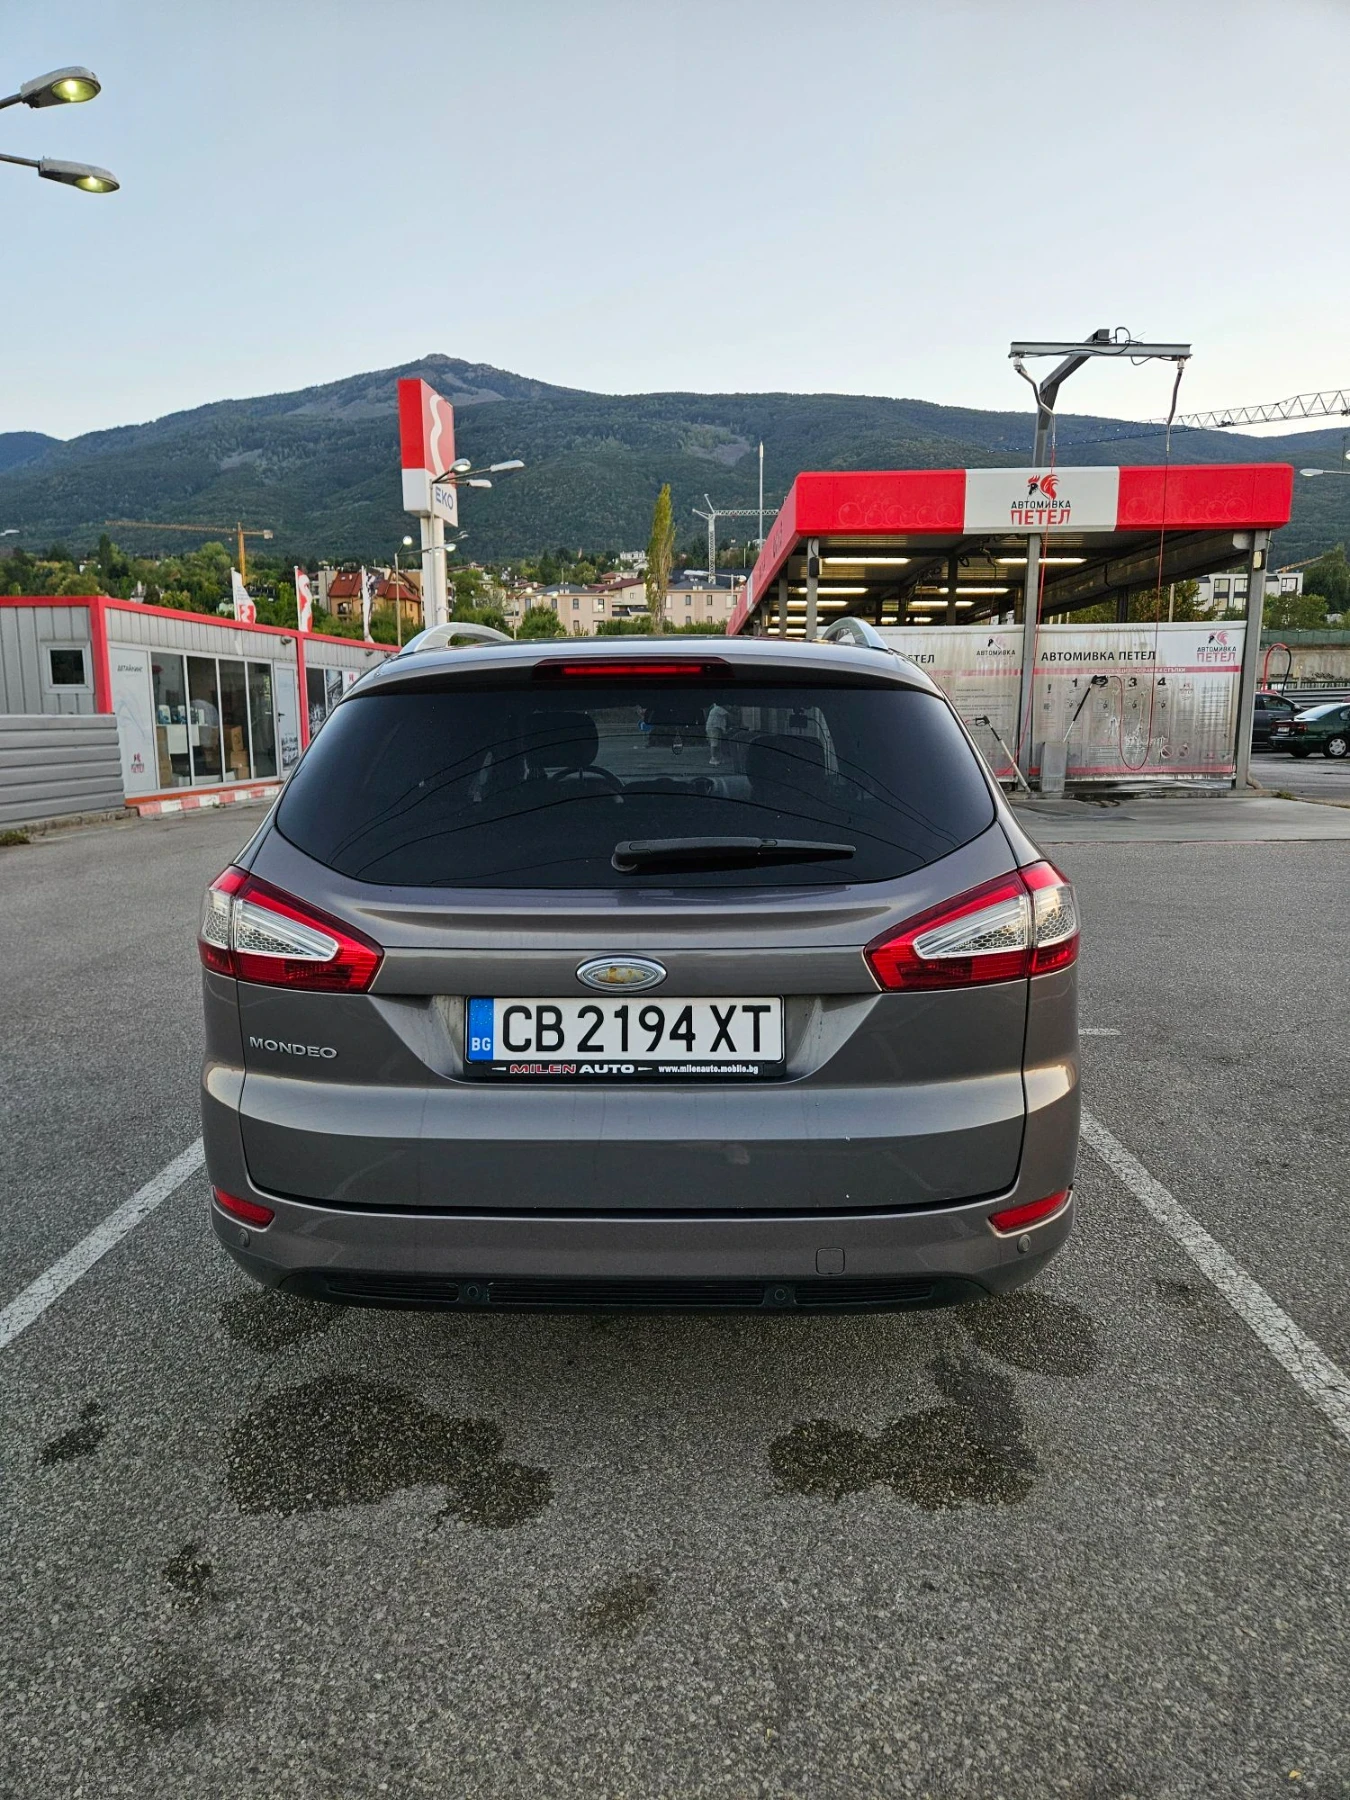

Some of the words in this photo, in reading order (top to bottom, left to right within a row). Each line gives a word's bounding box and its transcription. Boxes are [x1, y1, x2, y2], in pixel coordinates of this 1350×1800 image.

[435, 486, 454, 510] EKO
[1011, 500, 1071, 509] АВТОМИВКА
[1010, 509, 1071, 525] ПЕТЕЛ
[1041, 652, 1115, 661] АВТОМИВКА
[1118, 651, 1156, 660] ПЕТЕЛ
[1197, 652, 1236, 663] ПЕТЕЛ
[1072, 678, 1078, 688] 1
[1128, 677, 1138, 688] 3
[1157, 677, 1167, 687] 4
[249, 1036, 338, 1059] MONDEO
[471, 1037, 492, 1052] BG
[509, 1063, 577, 1075] MILEN
[578, 1063, 635, 1075] AUTO
[658, 1064, 759, 1076] www.milenauto.mobile.bg
